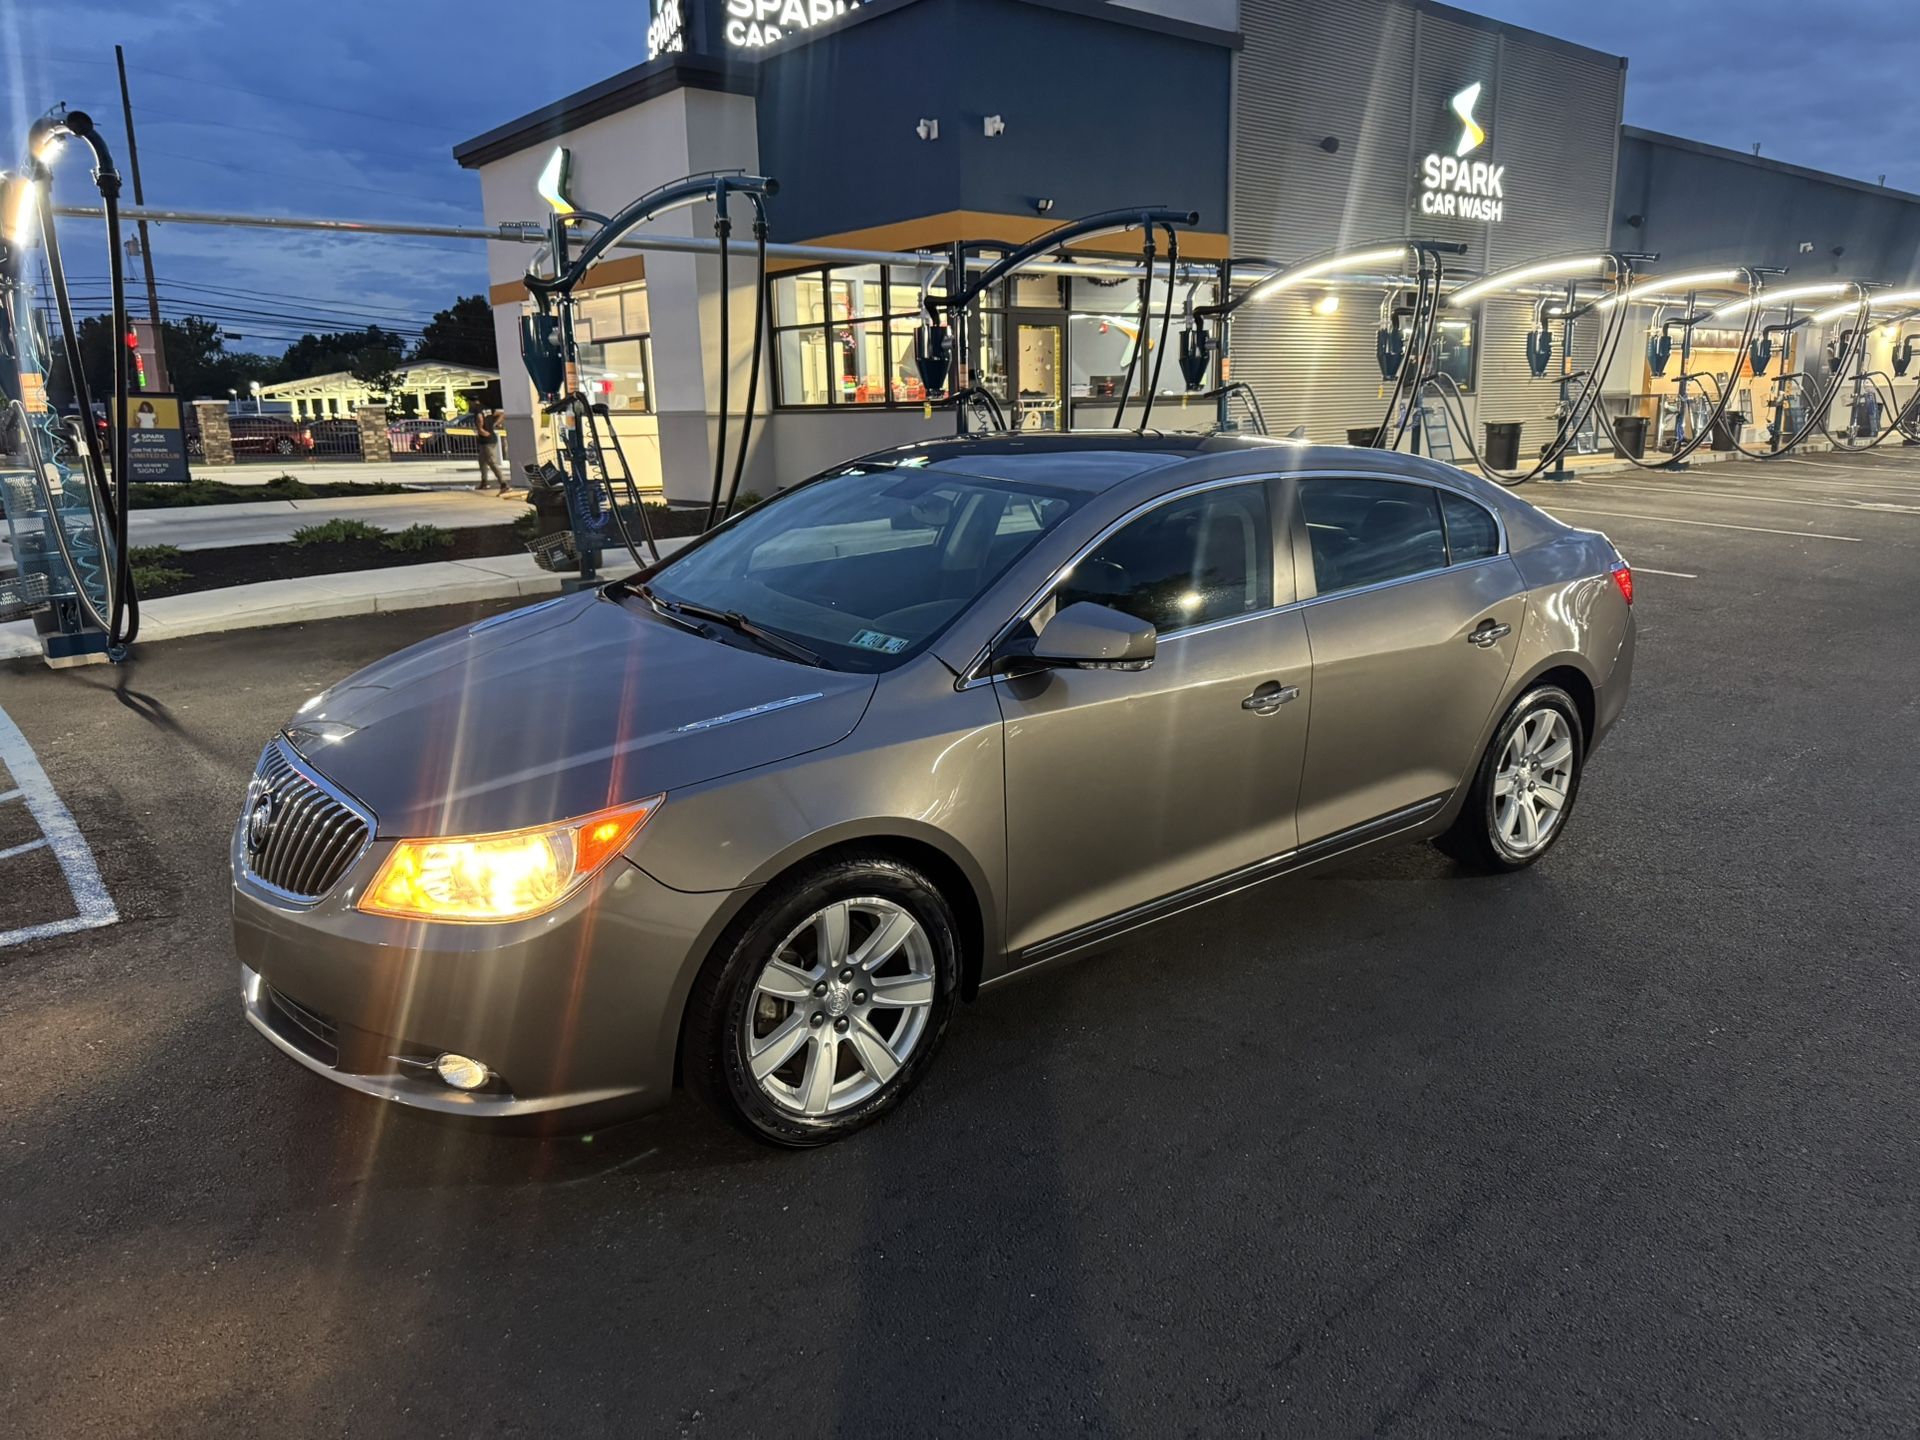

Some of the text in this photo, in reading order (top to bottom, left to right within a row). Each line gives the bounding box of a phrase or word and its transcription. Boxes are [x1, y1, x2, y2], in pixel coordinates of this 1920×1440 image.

[1424, 153, 1505, 198] SPARK
[1422, 191, 1503, 222] CAR WASH
